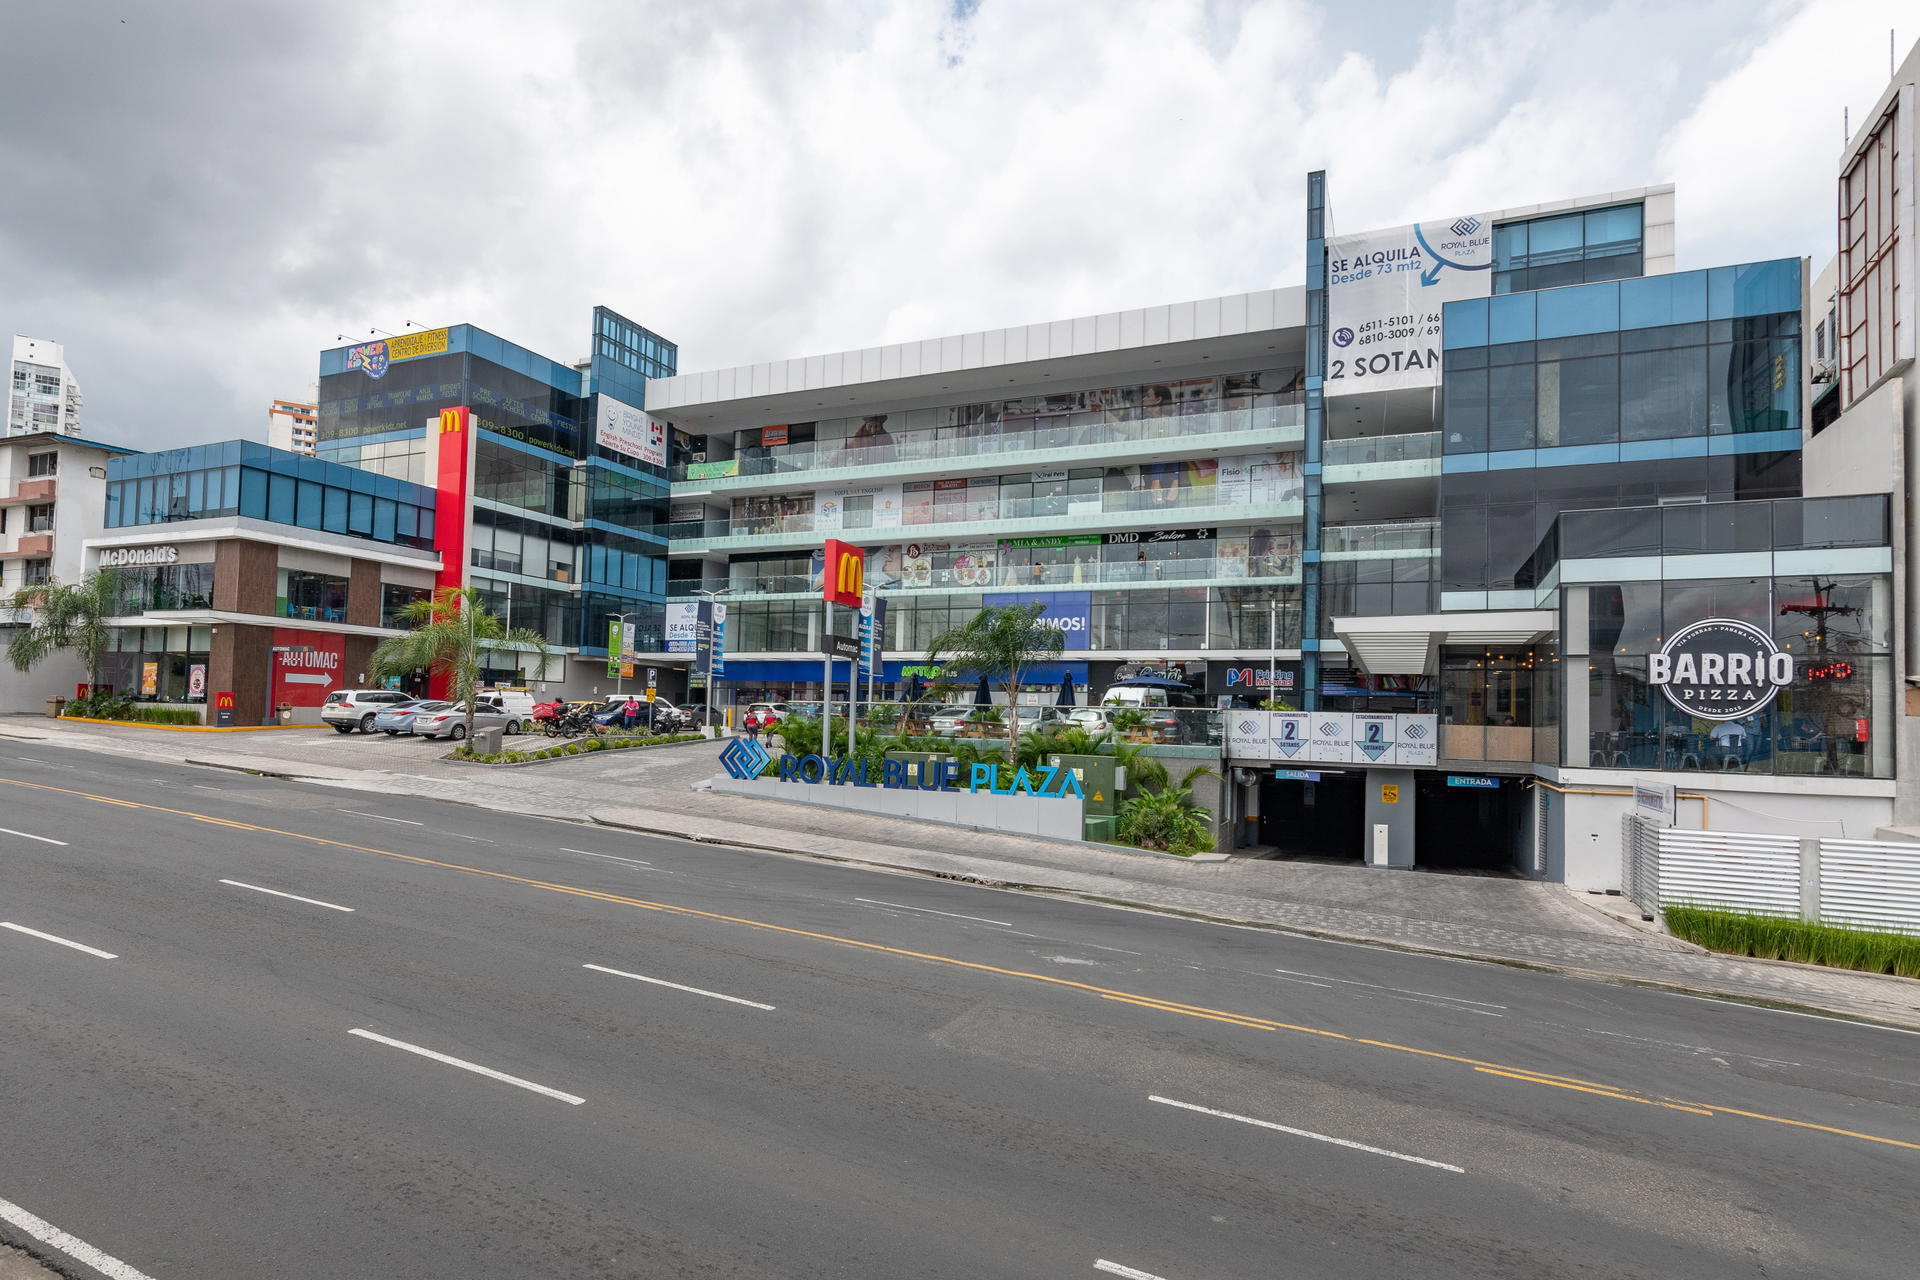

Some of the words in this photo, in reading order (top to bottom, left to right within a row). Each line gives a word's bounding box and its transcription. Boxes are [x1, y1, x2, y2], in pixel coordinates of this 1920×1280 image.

[1440, 241, 1467, 250] ROYAL
[1469, 236, 1490, 246] BLUE
[1332, 259, 1348, 273] SE
[1353, 246, 1421, 269] ALQUILA
[1454, 249, 1476, 257] PLAZA
[1332, 268, 1372, 285] Desde
[1377, 264, 1392, 275] 73
[1396, 260, 1422, 273] mt2
[1359, 315, 1414, 333] 6511-5101
[1427, 312, 1440, 323] 66
[1359, 328, 1414, 346] 6810-3009
[1427, 326, 1440, 335] 69
[412, 344, 419, 355] DE
[1331, 360, 1345, 380] 2
[472, 392, 498, 406] SCHOOL
[600, 429, 618, 442] English
[620, 437, 642, 450] Preschool
[644, 446, 663, 458] Program
[1031, 538, 1038, 546] &
[1040, 537, 1063, 546] ANDY
[1108, 533, 1139, 544] DMD
[99, 546, 177, 566] McDonald's
[670, 624, 678, 632] SE
[1720, 626, 1747, 638] PANAMA
[1748, 636, 1762, 648] CITY
[836, 640, 858, 654] Automac
[282, 650, 338, 669] AUTOMAC
[1256, 669, 1294, 680] Priting
[1684, 689, 1757, 700] PIZZA
[1698, 705, 1722, 713] DESDE
[1284, 722, 1296, 741] 2
[1368, 724, 1380, 744] 2
[1398, 742, 1418, 750] ROYAL
[780, 754, 877, 788] ROYAL
[883, 759, 961, 792] BLUE
[970, 762, 1086, 800] PLAZA
[1455, 776, 1493, 786] ENTRADA
